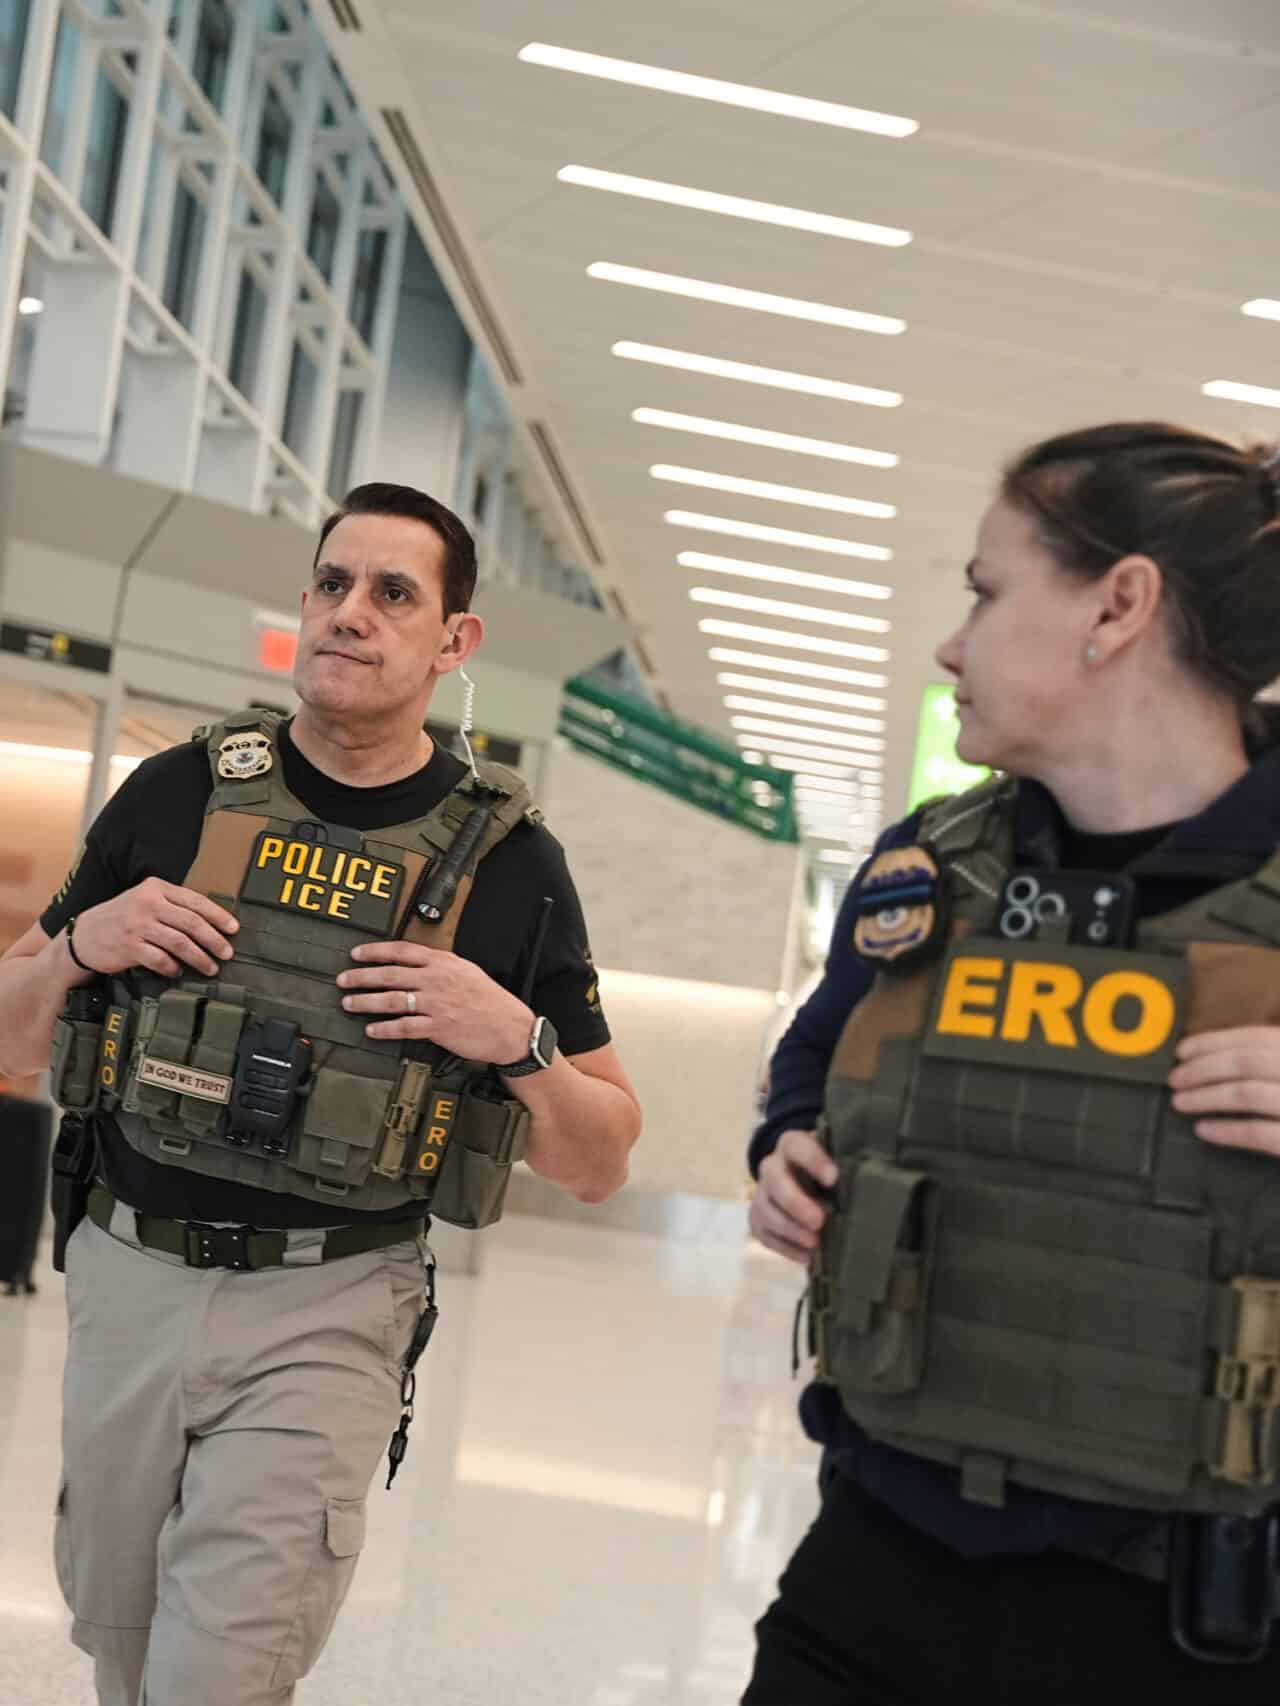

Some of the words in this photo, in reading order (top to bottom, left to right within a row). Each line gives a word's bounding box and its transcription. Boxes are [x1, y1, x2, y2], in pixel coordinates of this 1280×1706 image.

[256, 836, 397, 899] POLICE
[279, 879, 355, 920] ICE
[935, 956, 1177, 1057] ERO
[102, 1012, 123, 1085] ERO
[144, 1063, 155, 1075] IN
[156, 1067, 177, 1081] GOD
[179, 1073, 193, 1086] WE
[195, 1078, 225, 1094] TRUST
[419, 1099, 454, 1171] ERO
